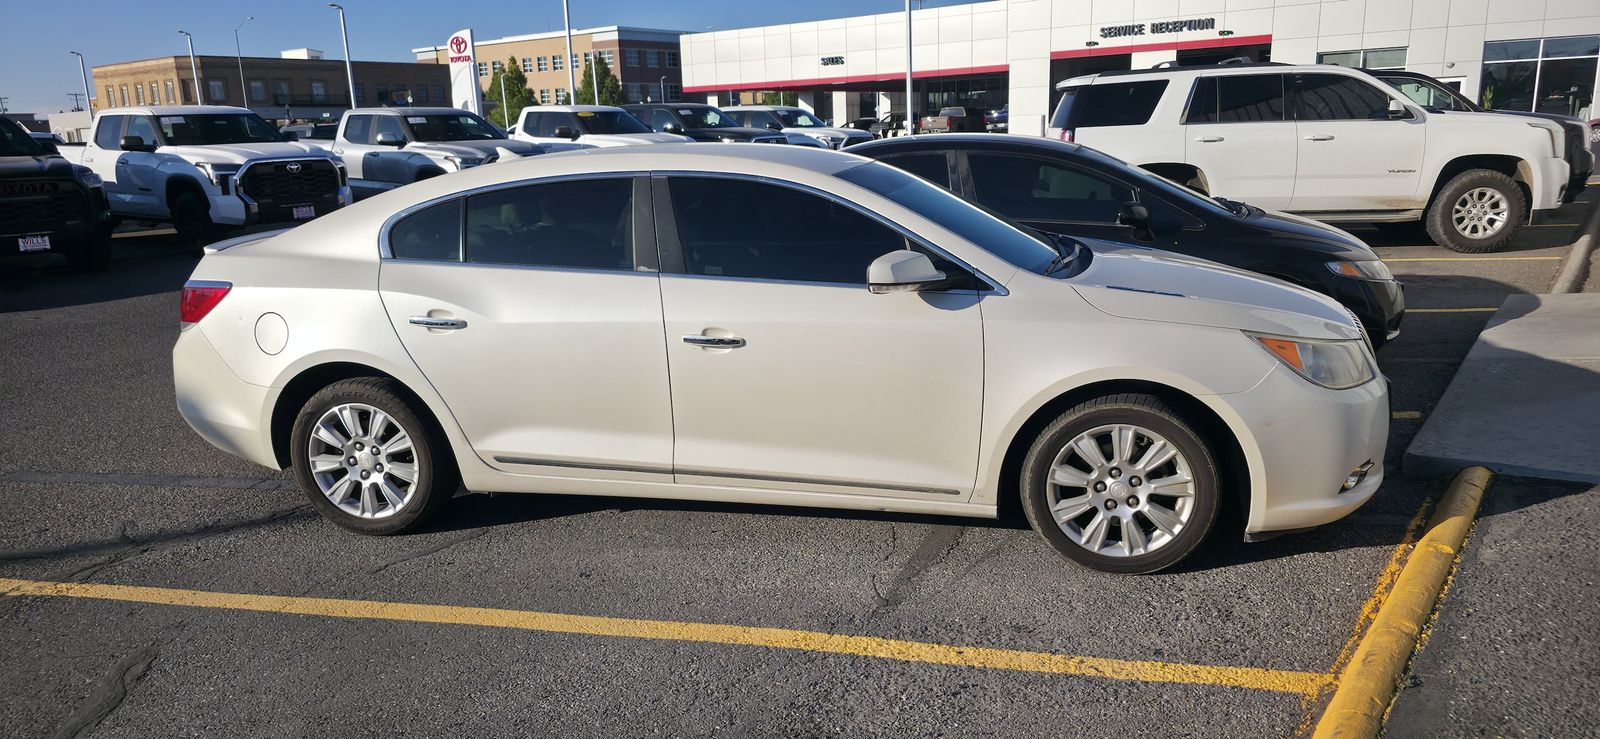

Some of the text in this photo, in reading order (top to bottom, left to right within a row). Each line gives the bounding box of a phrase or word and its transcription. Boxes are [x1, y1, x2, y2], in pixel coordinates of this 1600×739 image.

[1100, 18, 1215, 38] SERVICE RECEPTION
[820, 56, 844, 66] SALES
[0, 183, 54, 194] OYOTA
[21, 237, 47, 245] WILLS
